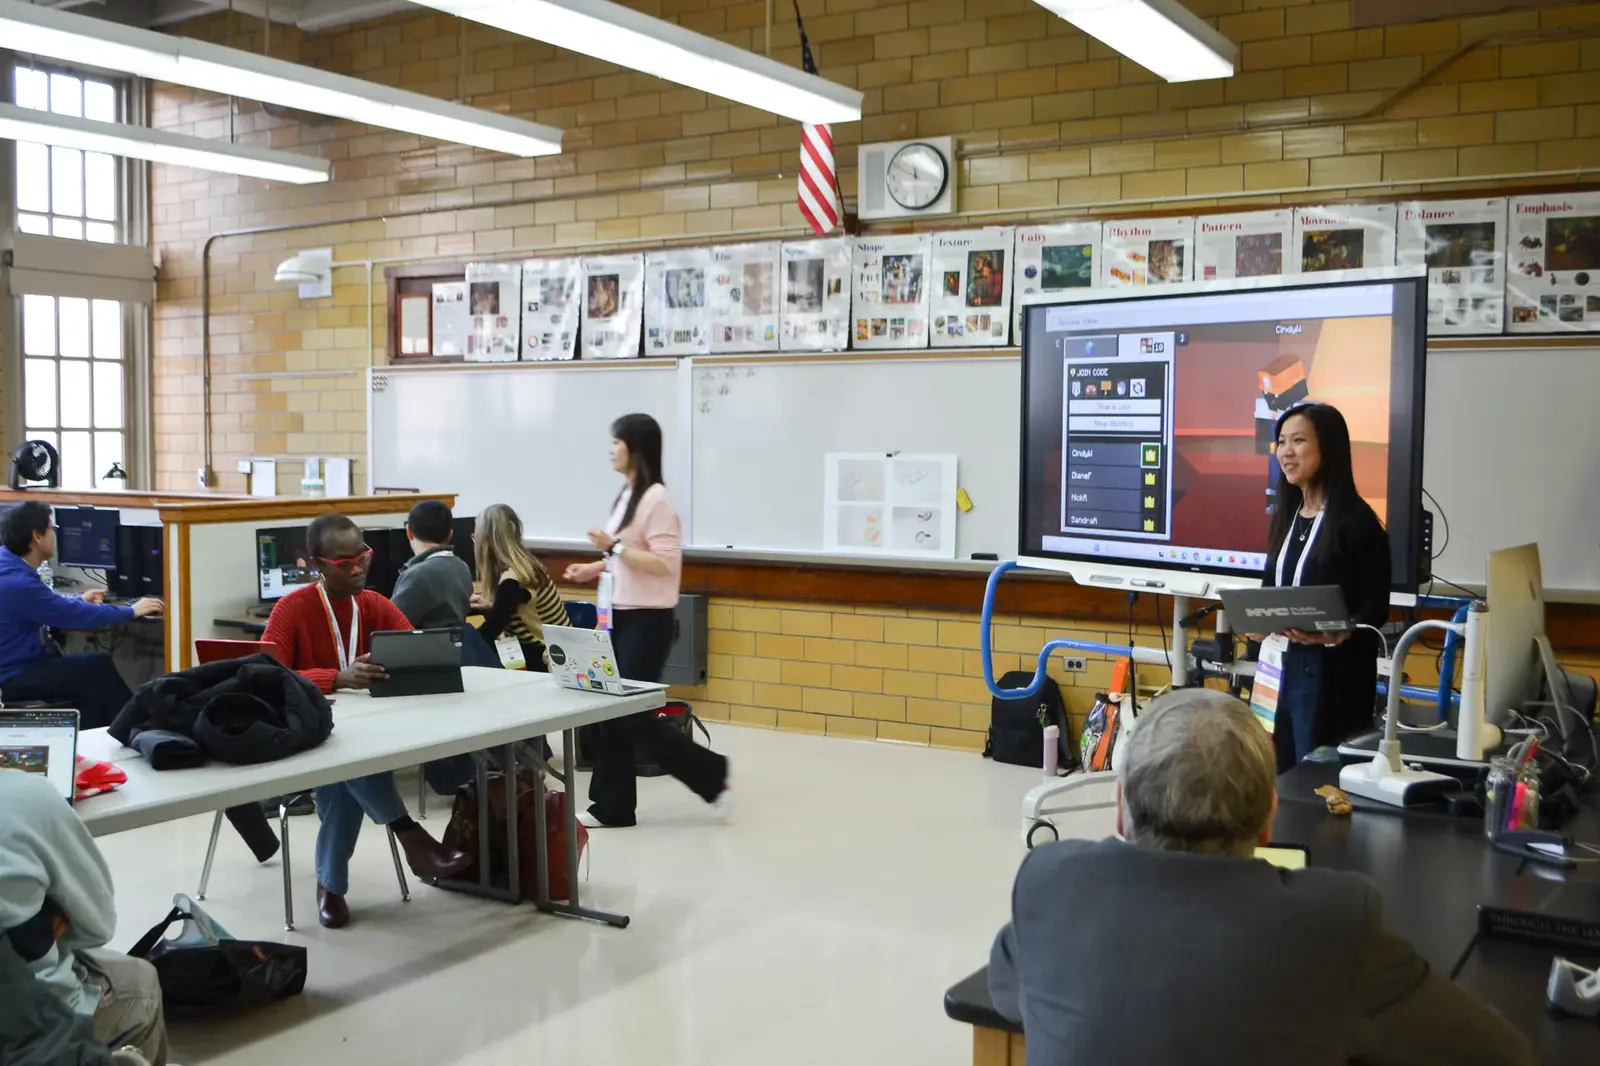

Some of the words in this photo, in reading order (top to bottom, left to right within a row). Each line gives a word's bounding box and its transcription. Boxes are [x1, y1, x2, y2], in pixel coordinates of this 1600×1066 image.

[1516, 202, 1573, 214] Emphasis
[1405, 209, 1455, 220] Balance
[1201, 222, 1242, 232] Pattern
[1110, 227, 1152, 239] Rhythm
[857, 243, 885, 251] Shape
[939, 238, 973, 247] Texture
[1077, 368, 1091, 377] JOIN
[1092, 368, 1109, 377] CODE
[1245, 607, 1290, 617] NYC
